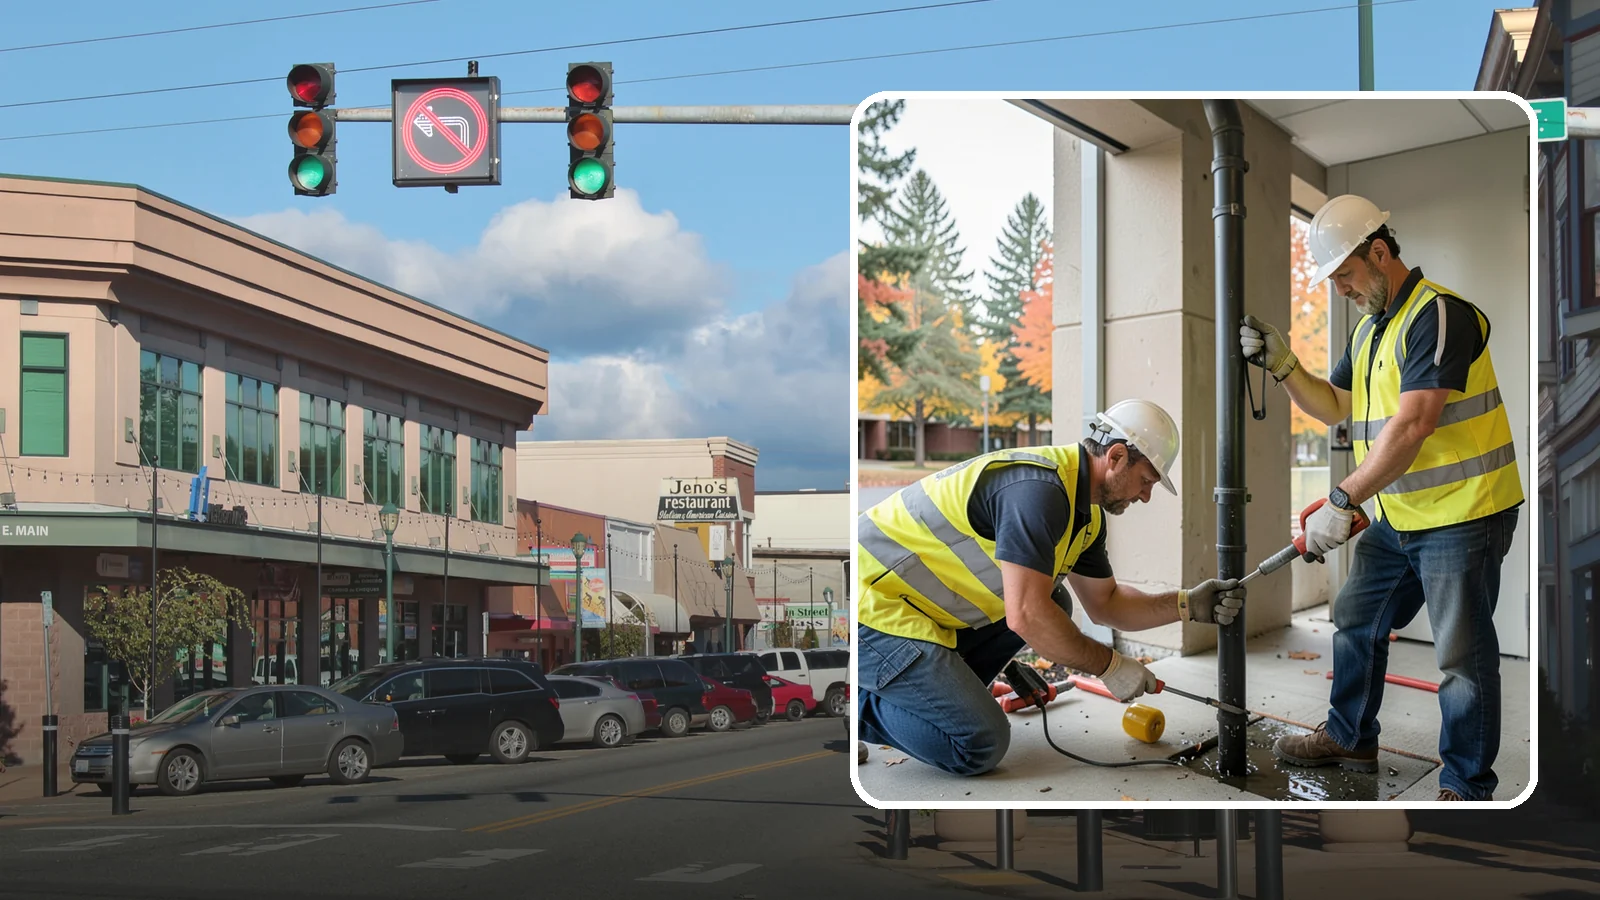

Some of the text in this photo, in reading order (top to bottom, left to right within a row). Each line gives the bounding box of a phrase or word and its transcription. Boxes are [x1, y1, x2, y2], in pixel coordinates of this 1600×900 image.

[669, 480, 727, 494] Jeno's
[665, 496, 731, 509] restaurant
[686, 510, 714, 519] American
[715, 510, 737, 519] Cuisine
[2, 525, 49, 536] E. MAIN
[797, 607, 828, 617] Street
